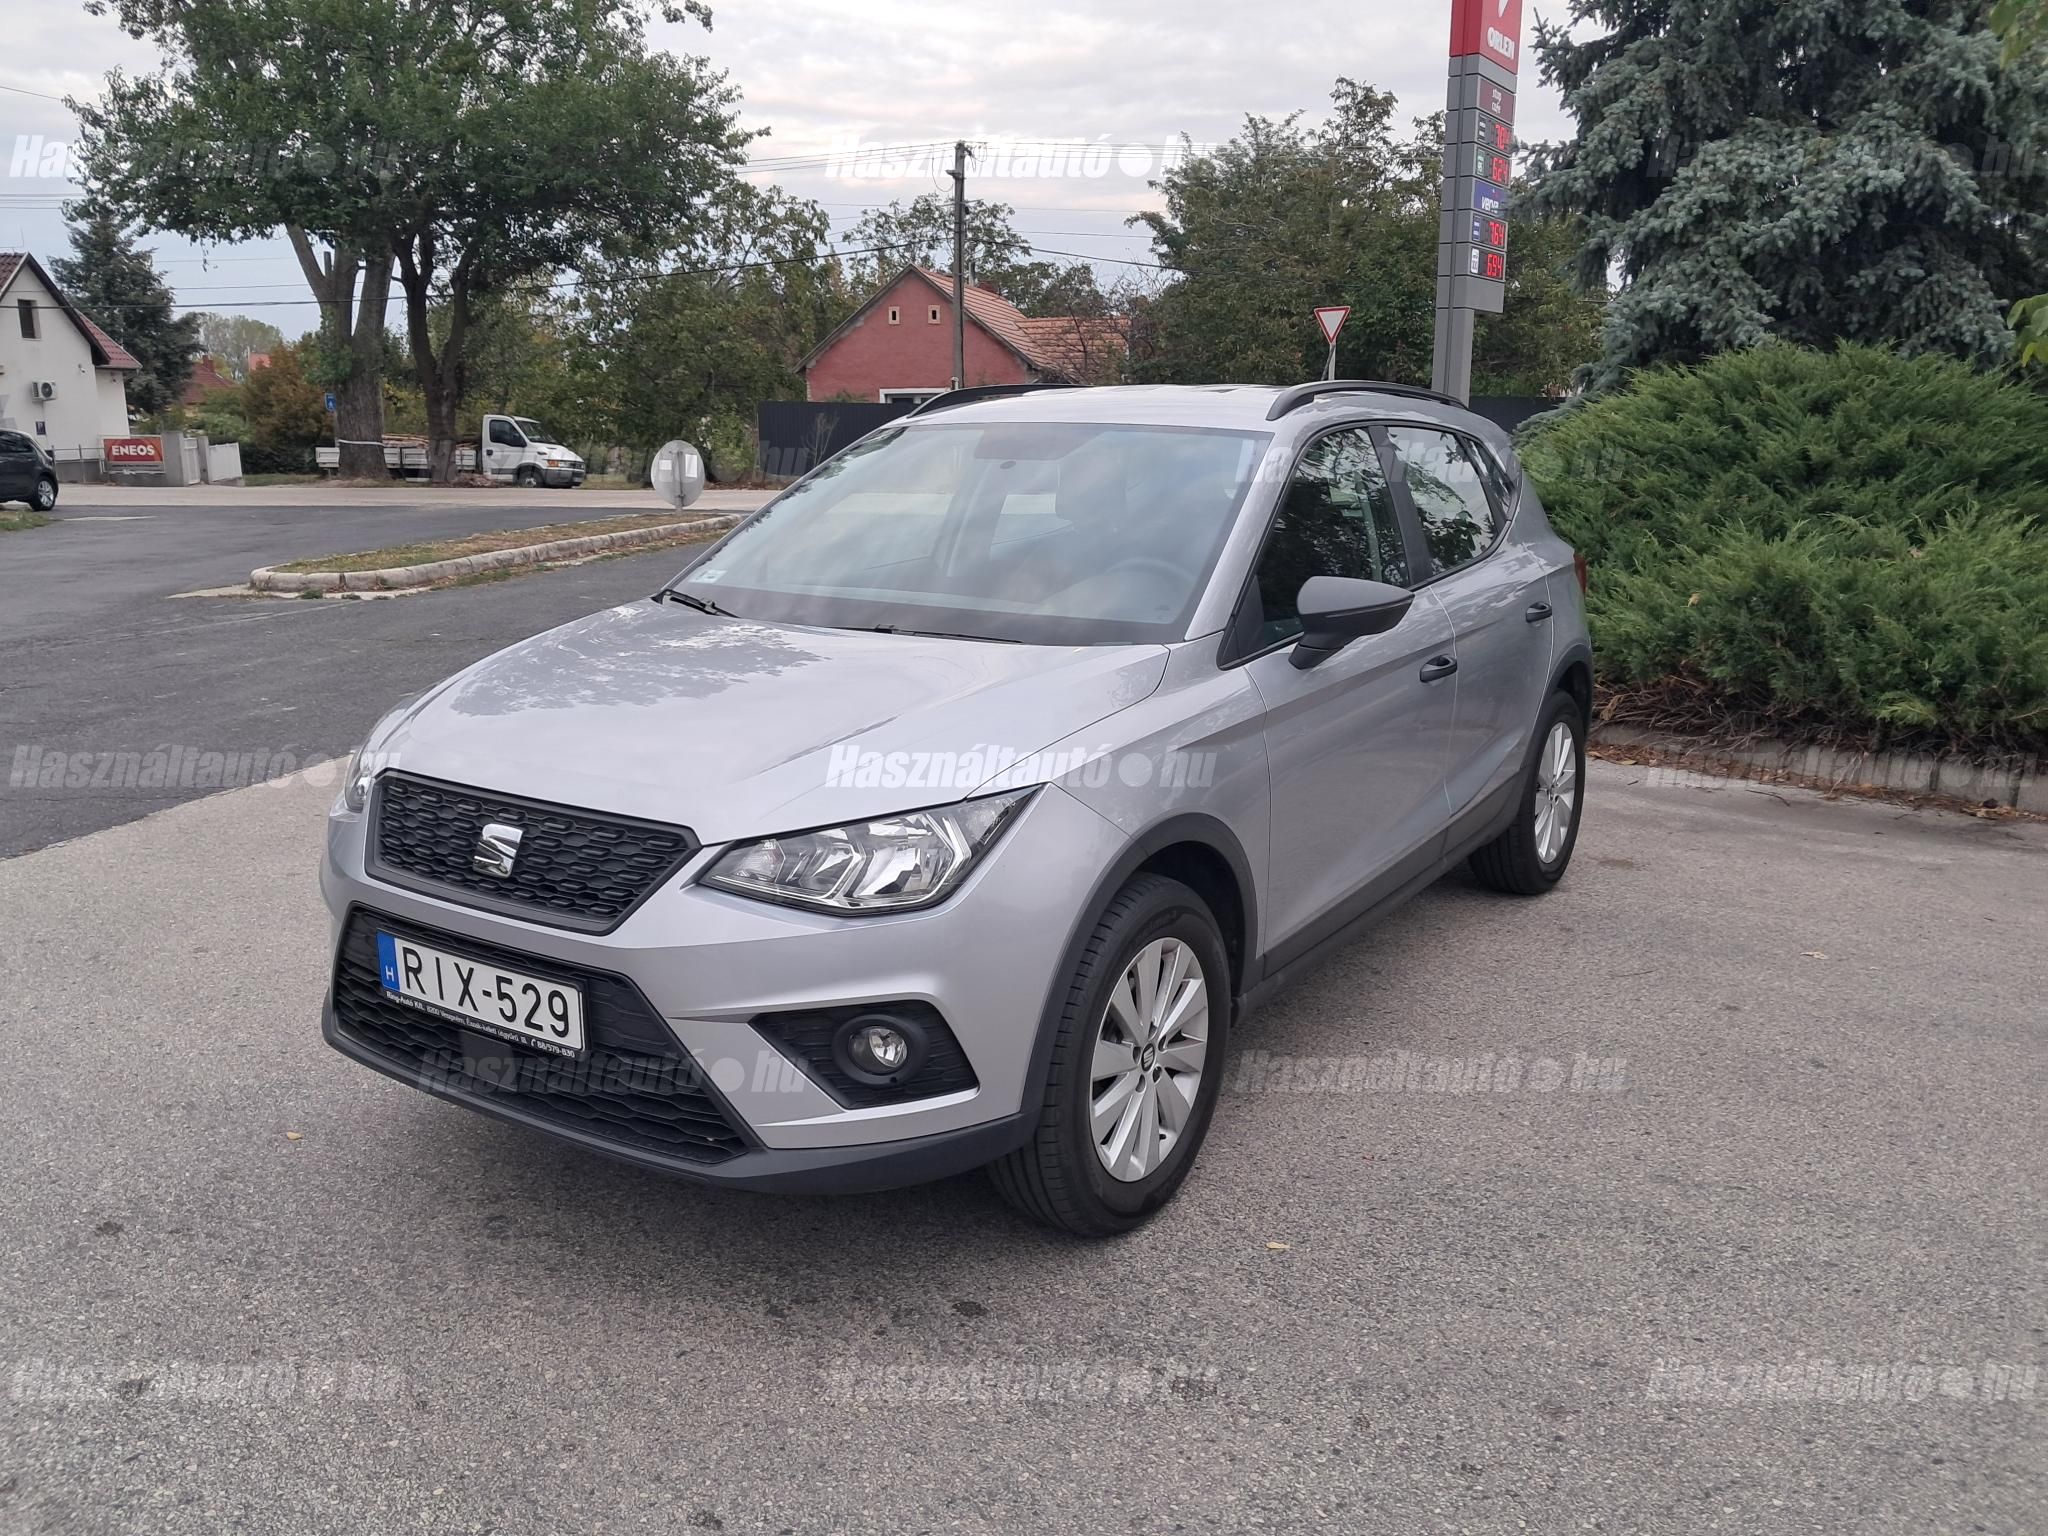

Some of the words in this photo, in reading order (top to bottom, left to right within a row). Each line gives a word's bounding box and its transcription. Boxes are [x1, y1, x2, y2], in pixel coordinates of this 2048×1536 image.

[111, 445, 155, 456] ENEOS
[385, 965, 395, 982] H
[402, 946, 569, 1038] RIX-529
